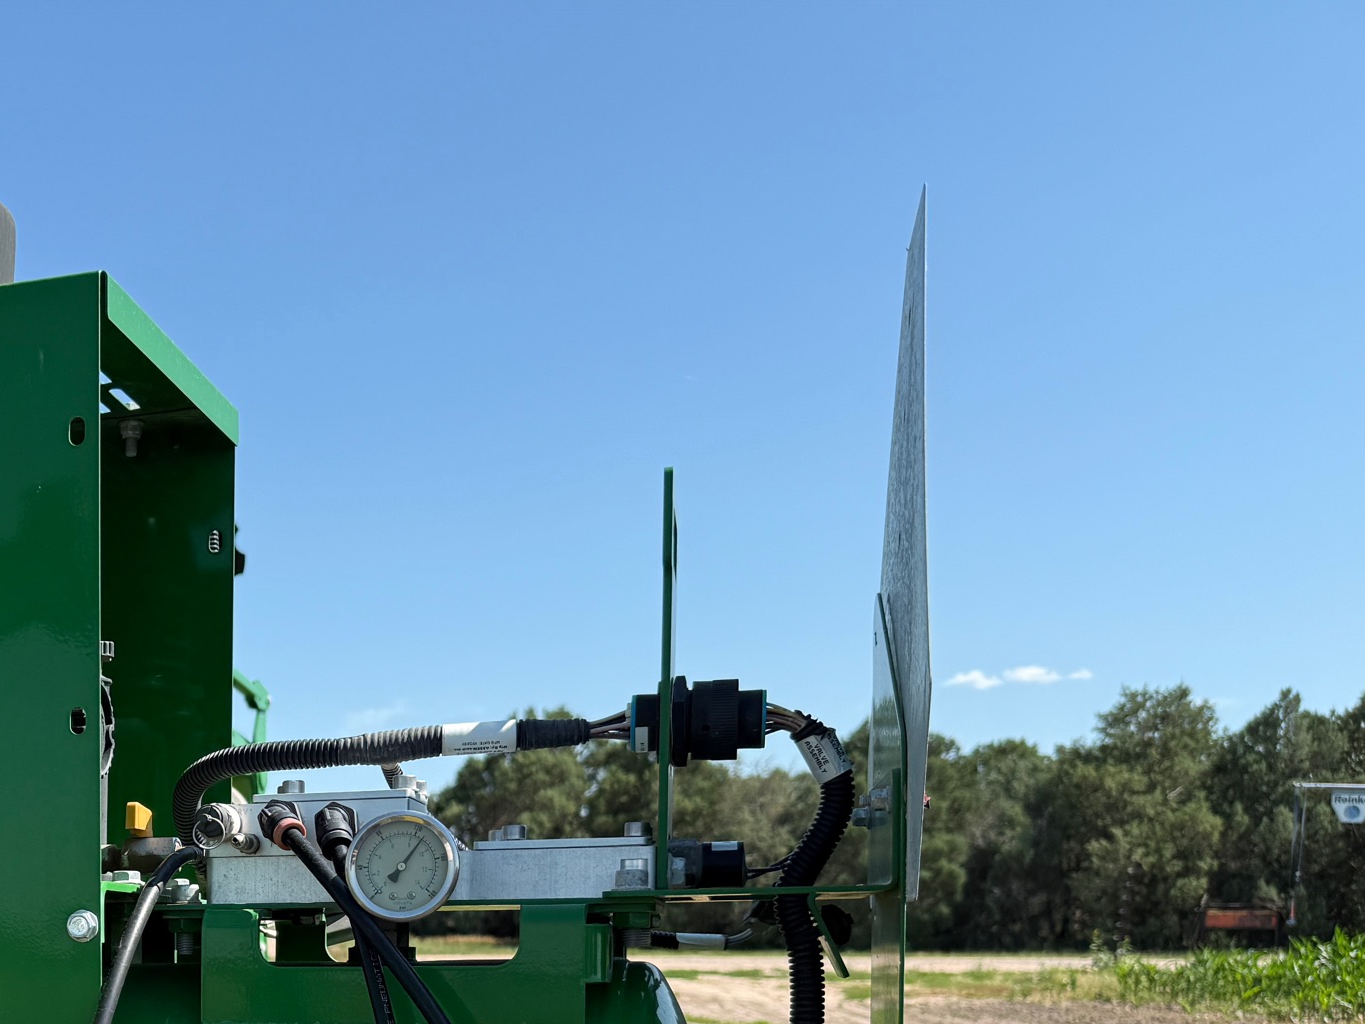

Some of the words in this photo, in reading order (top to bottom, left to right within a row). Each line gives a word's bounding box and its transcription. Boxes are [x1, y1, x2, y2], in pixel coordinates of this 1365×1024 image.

[804, 741, 828, 773] ASSEMBLY
[814, 743, 830, 765] VALVE
[1335, 795, 1365, 804] Reink
